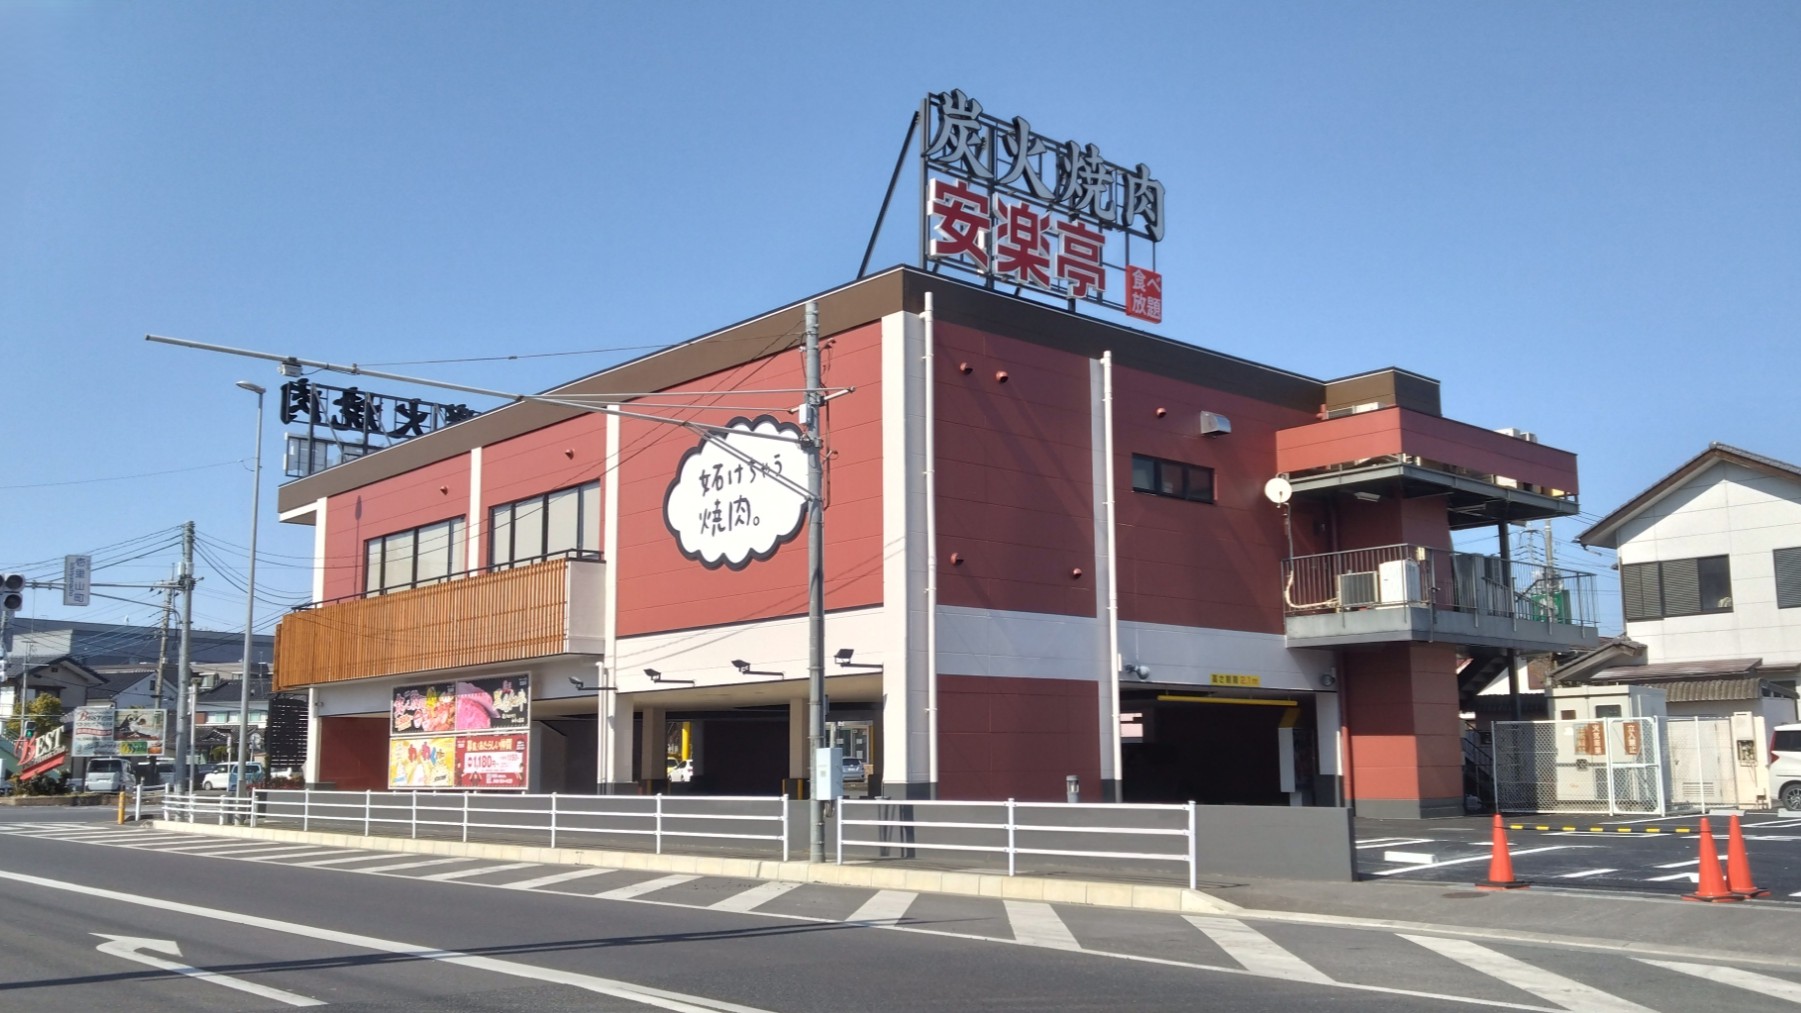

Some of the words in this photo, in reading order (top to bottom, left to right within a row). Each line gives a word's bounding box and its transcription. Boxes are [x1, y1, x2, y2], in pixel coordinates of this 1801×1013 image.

[923, 88, 1166, 242] 炭火焼肉
[927, 176, 1106, 299] 安楽亭
[1131, 269, 1162, 293] 食べ
[1131, 293, 1162, 320] 放題
[699, 453, 784, 496] 妬けちゃう
[699, 494, 761, 537] 焼肉。
[13, 725, 65, 766] BEST
